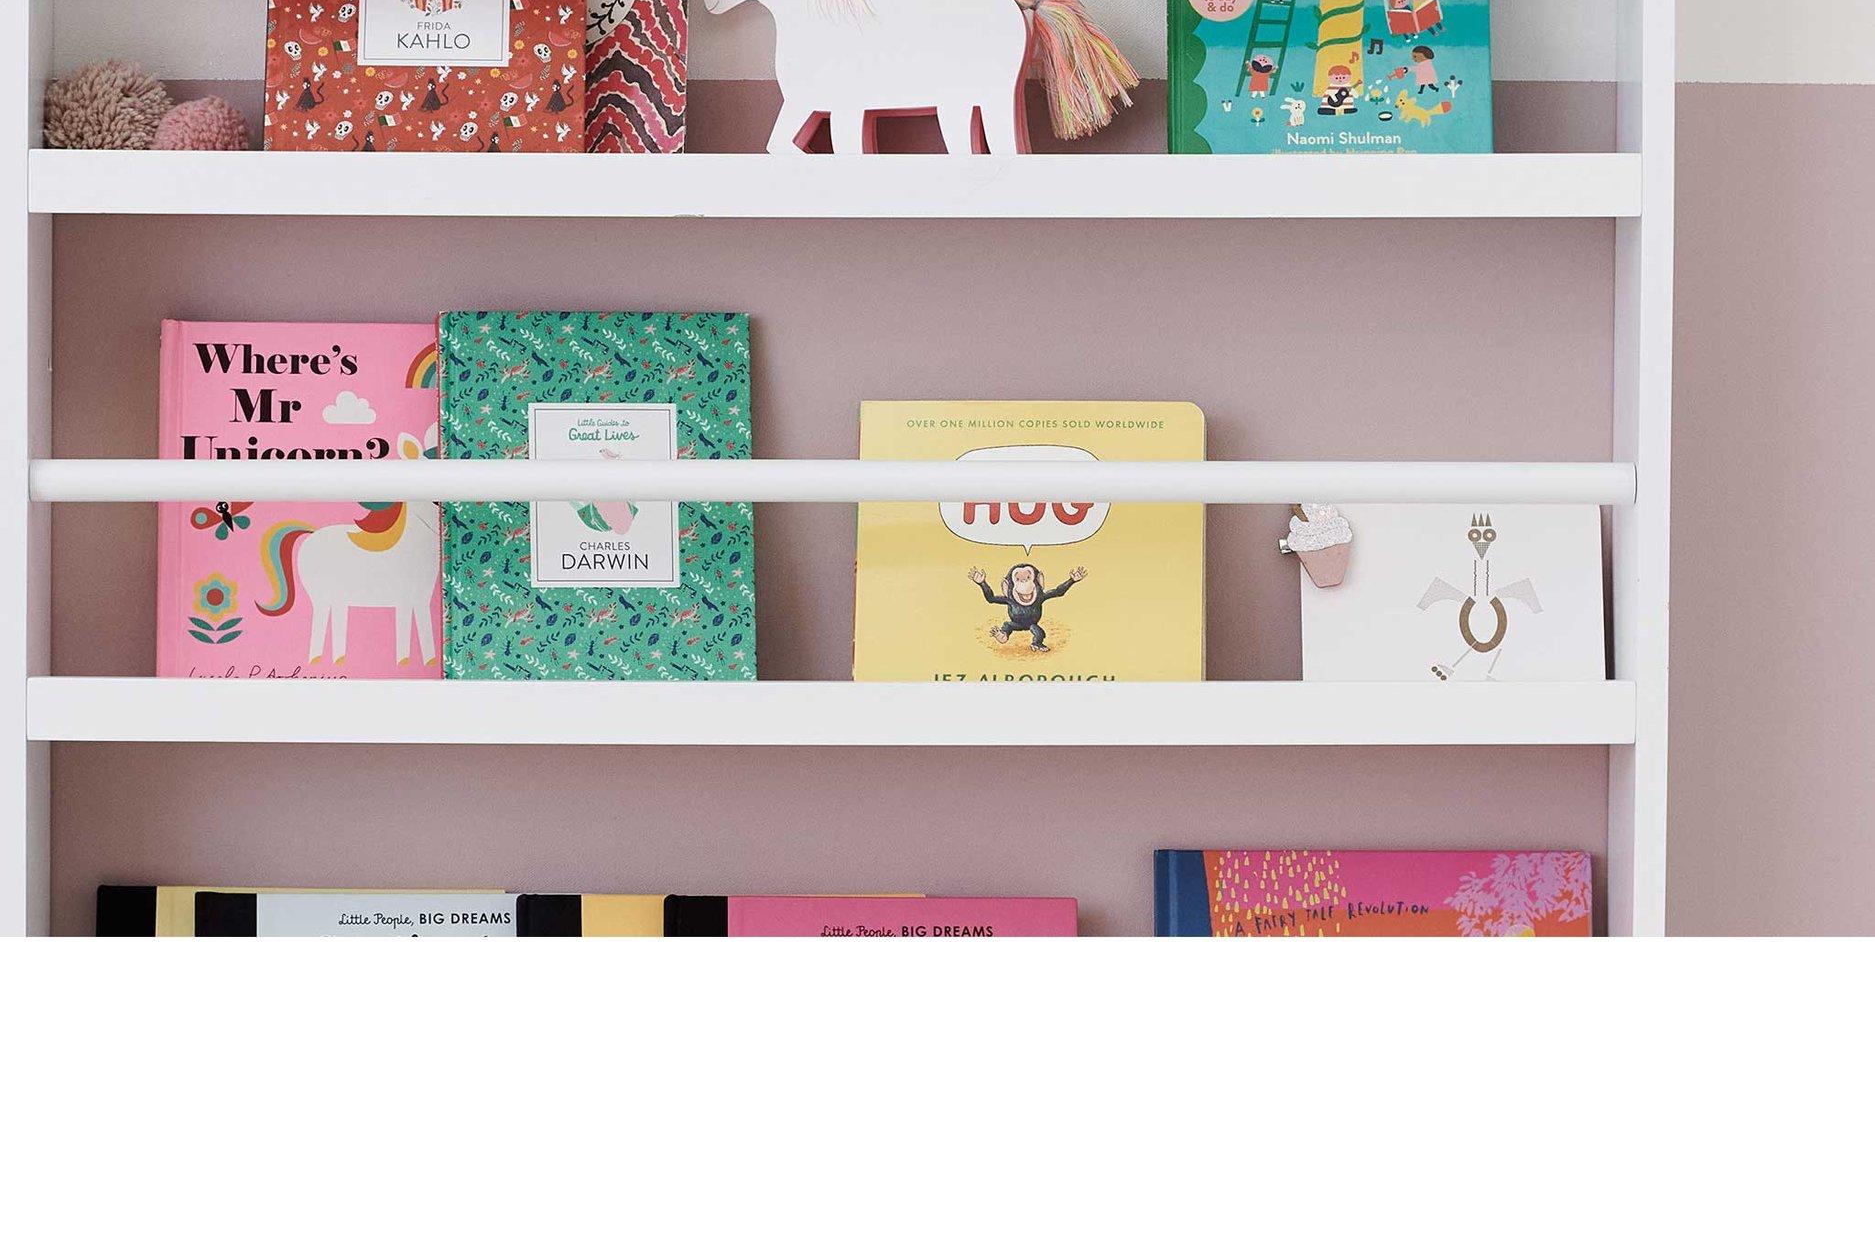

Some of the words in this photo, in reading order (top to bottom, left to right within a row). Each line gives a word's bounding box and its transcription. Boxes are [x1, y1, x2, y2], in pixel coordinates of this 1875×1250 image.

[1207, 2, 1216, 12] &
[1220, 2, 1234, 12] do
[417, 21, 452, 31] FRIDA
[397, 33, 471, 50] KAHLO
[1286, 132, 1334, 145] Naomi
[1338, 131, 1401, 145] Shulman
[192, 343, 358, 376] Where's
[229, 388, 302, 424] Mr
[577, 418, 596, 427] Little
[620, 419, 630, 427] to
[906, 419, 936, 428] OVER
[939, 419, 964, 428] ONE
[968, 419, 1014, 429] MILLION
[1018, 419, 1058, 429] COPIES
[1062, 419, 1091, 429] SOLD
[1095, 420, 1165, 429] WORLDWIDE
[568, 428, 601, 441] Great
[605, 429, 640, 441] Lives
[579, 542, 631, 551] CHARLES
[562, 554, 648, 570] DARWIN
[338, 913, 371, 925] Little
[373, 913, 414, 929] People,
[419, 913, 445, 925] BIG
[451, 913, 511, 925] DREAMS
[1235, 922, 1246, 937] A
[1305, 905, 1334, 922] TALE
[1348, 901, 1429, 919] REVOLUTION
[820, 925, 853, 937] Little
[902, 926, 927, 937] BIG
[933, 926, 994, 937] DREAMS
